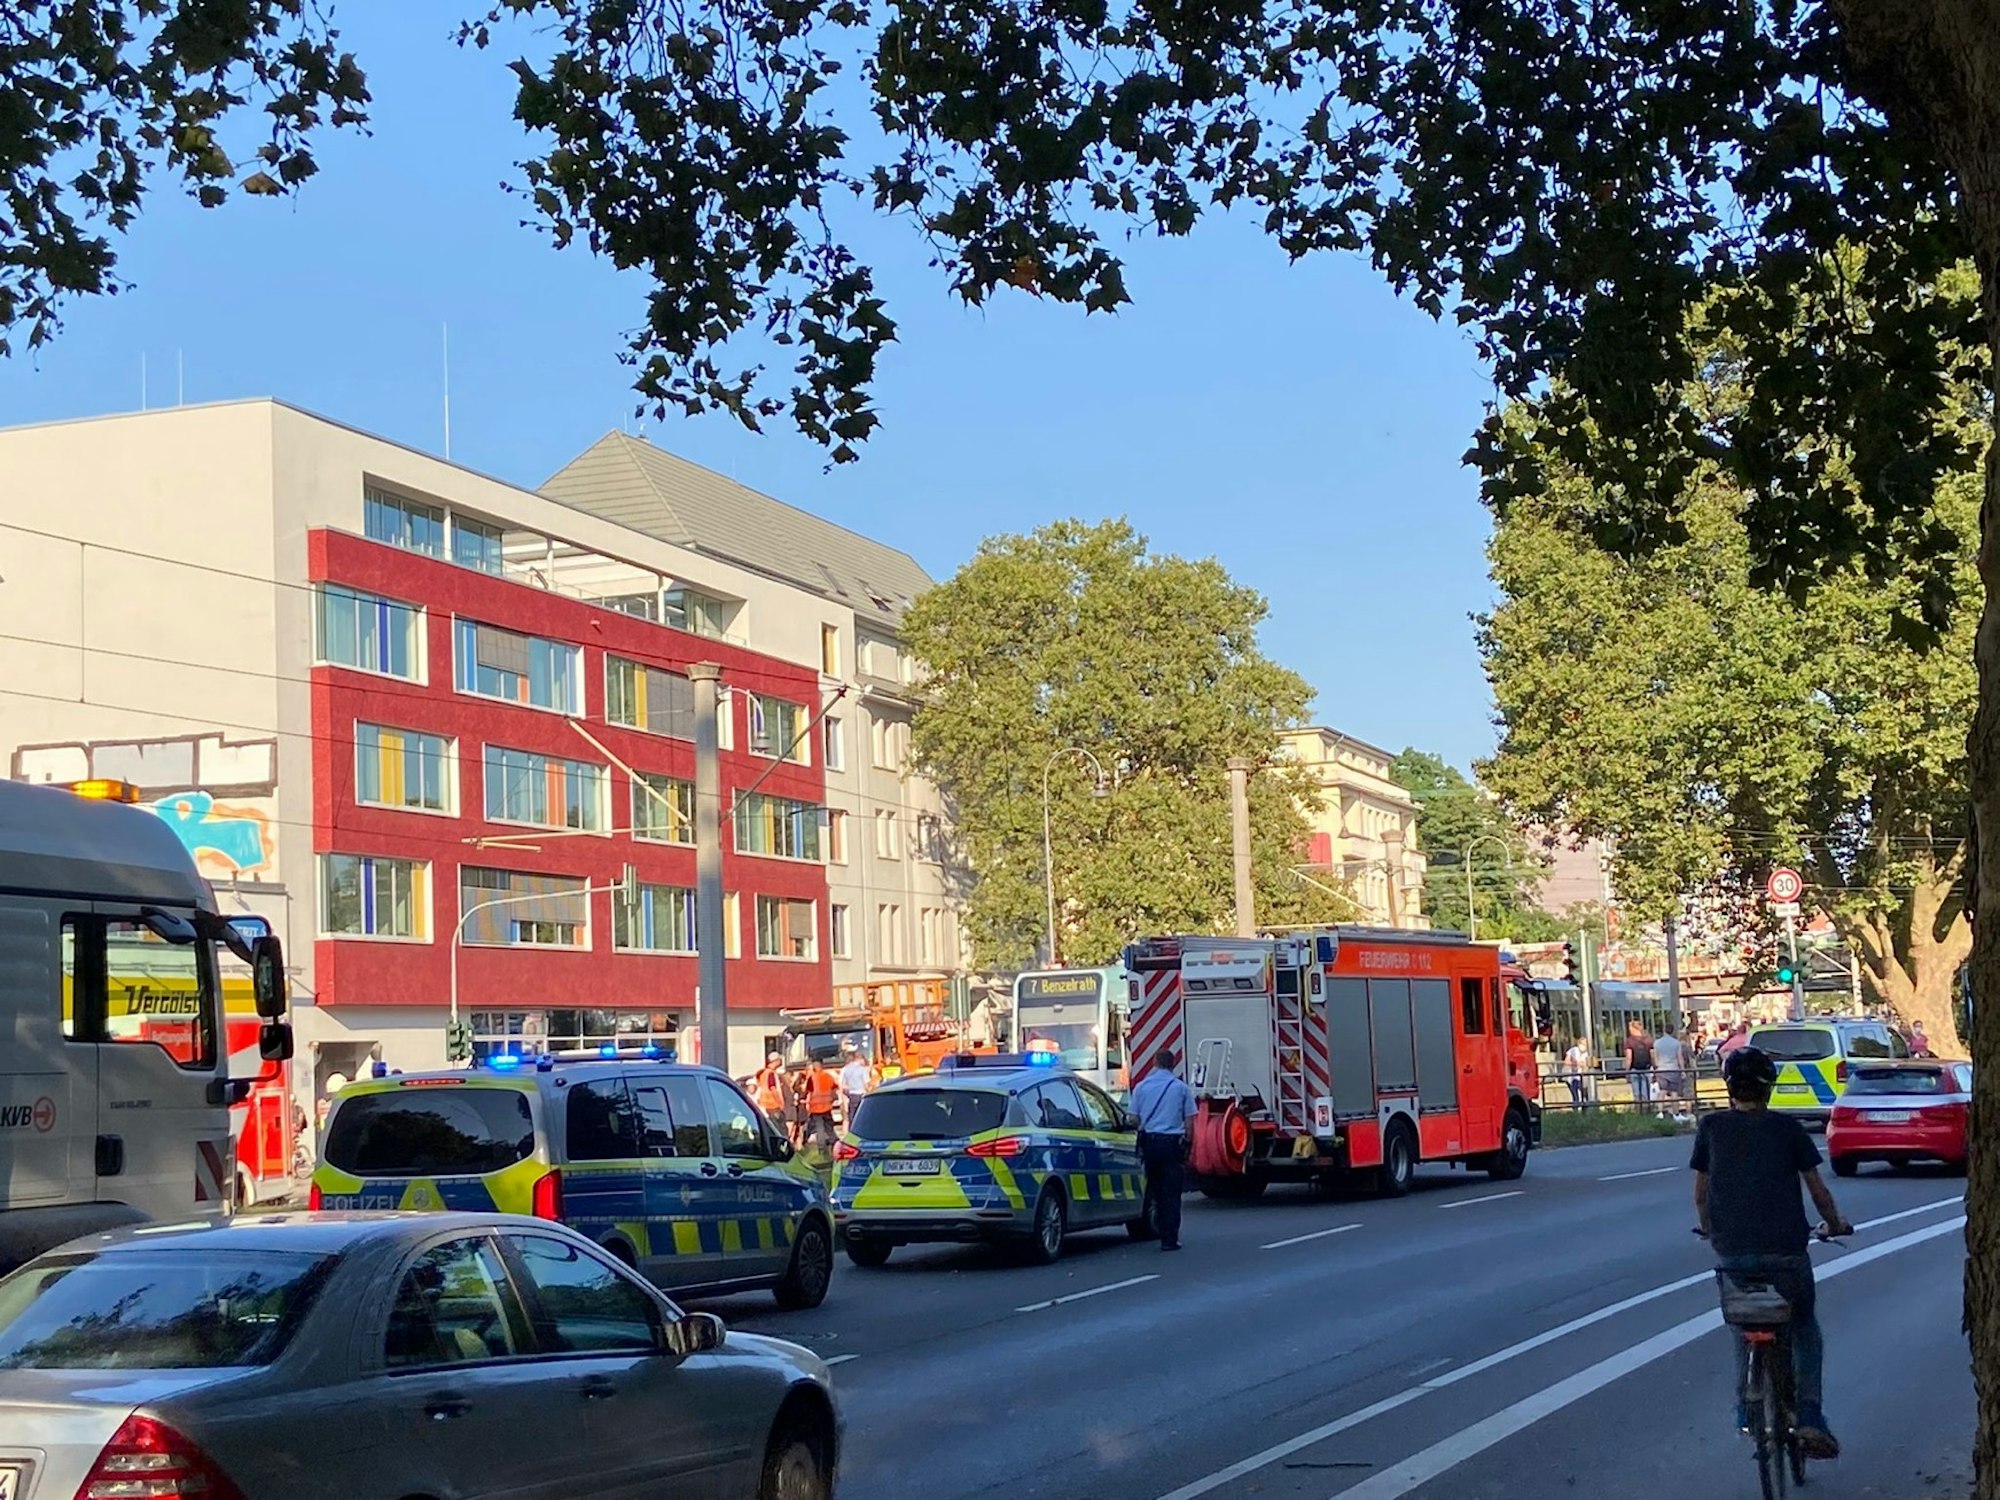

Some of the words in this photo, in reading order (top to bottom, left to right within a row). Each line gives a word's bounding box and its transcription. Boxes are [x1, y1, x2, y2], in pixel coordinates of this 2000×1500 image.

[1776, 878, 1794, 892] 30
[1359, 951, 1410, 969] FEUERWEHR
[1418, 952, 1432, 970] 112
[1030, 980, 1038, 994] 7
[1041, 976, 1097, 994] Benzelrath
[0, 1106, 32, 1127] KVB
[323, 1195, 394, 1210] POLIZEI
